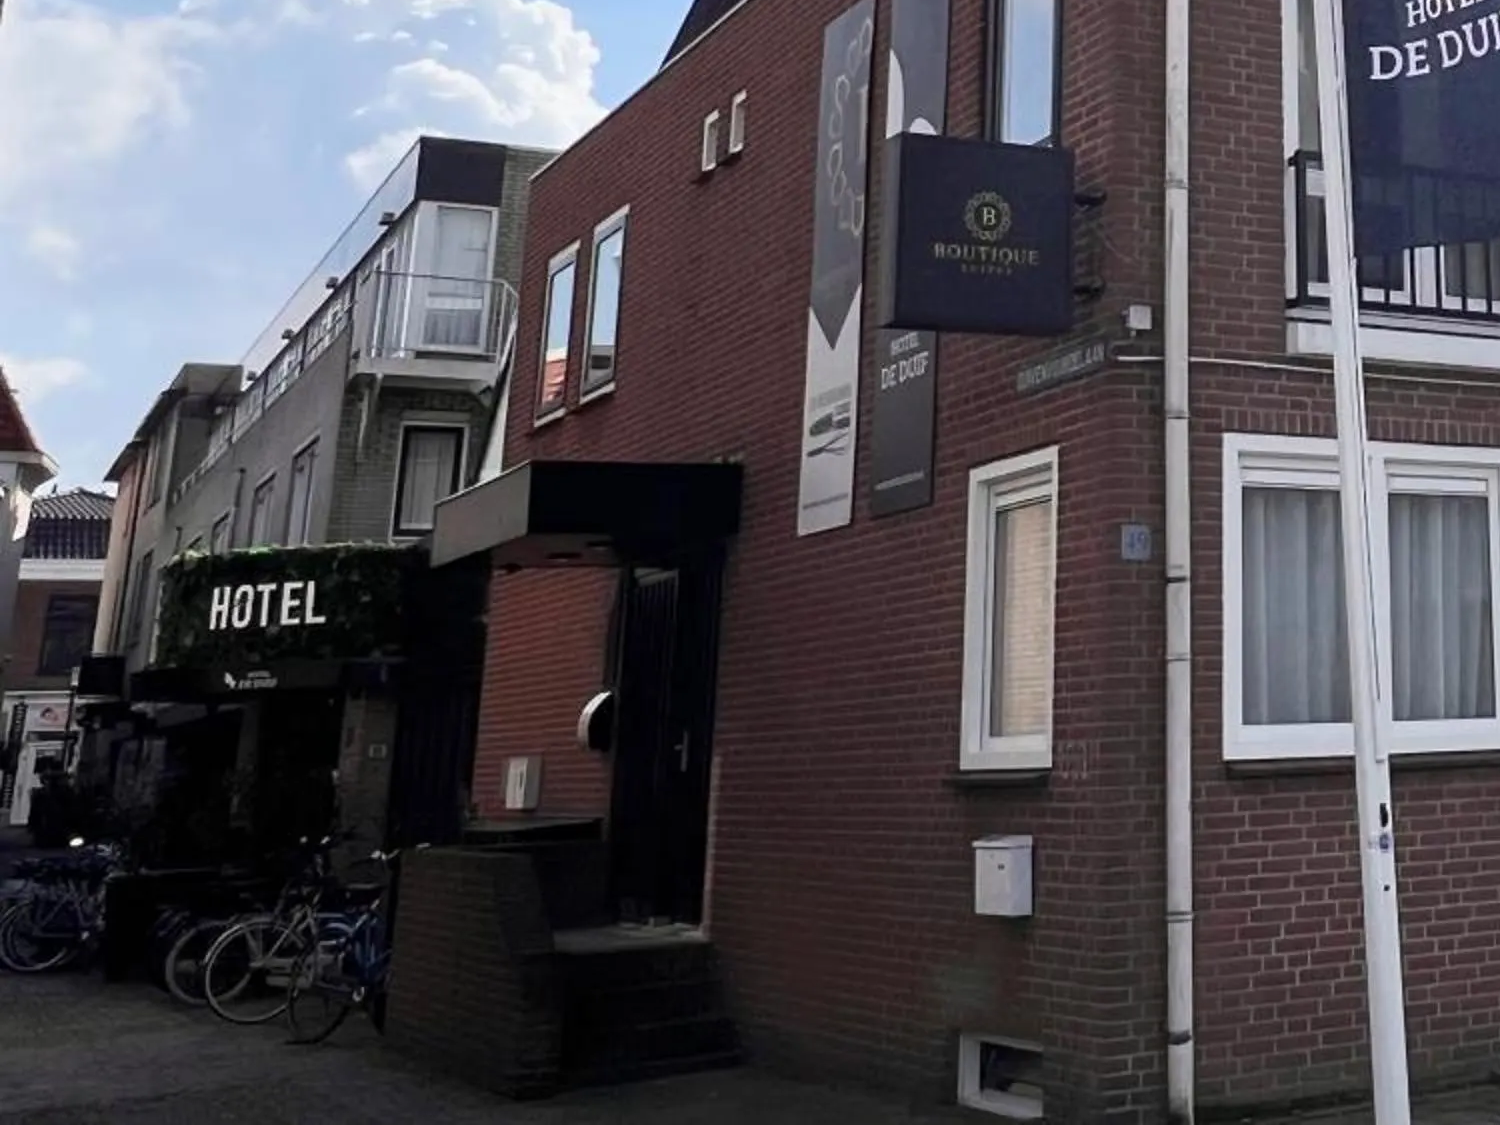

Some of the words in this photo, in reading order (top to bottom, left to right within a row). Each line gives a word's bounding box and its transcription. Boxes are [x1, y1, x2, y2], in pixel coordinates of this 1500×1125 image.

[1368, 38, 1431, 80] DE
[933, 241, 1041, 266] BOUTIQUE
[880, 364, 897, 390] DE
[209, 580, 327, 630] HOTEL
